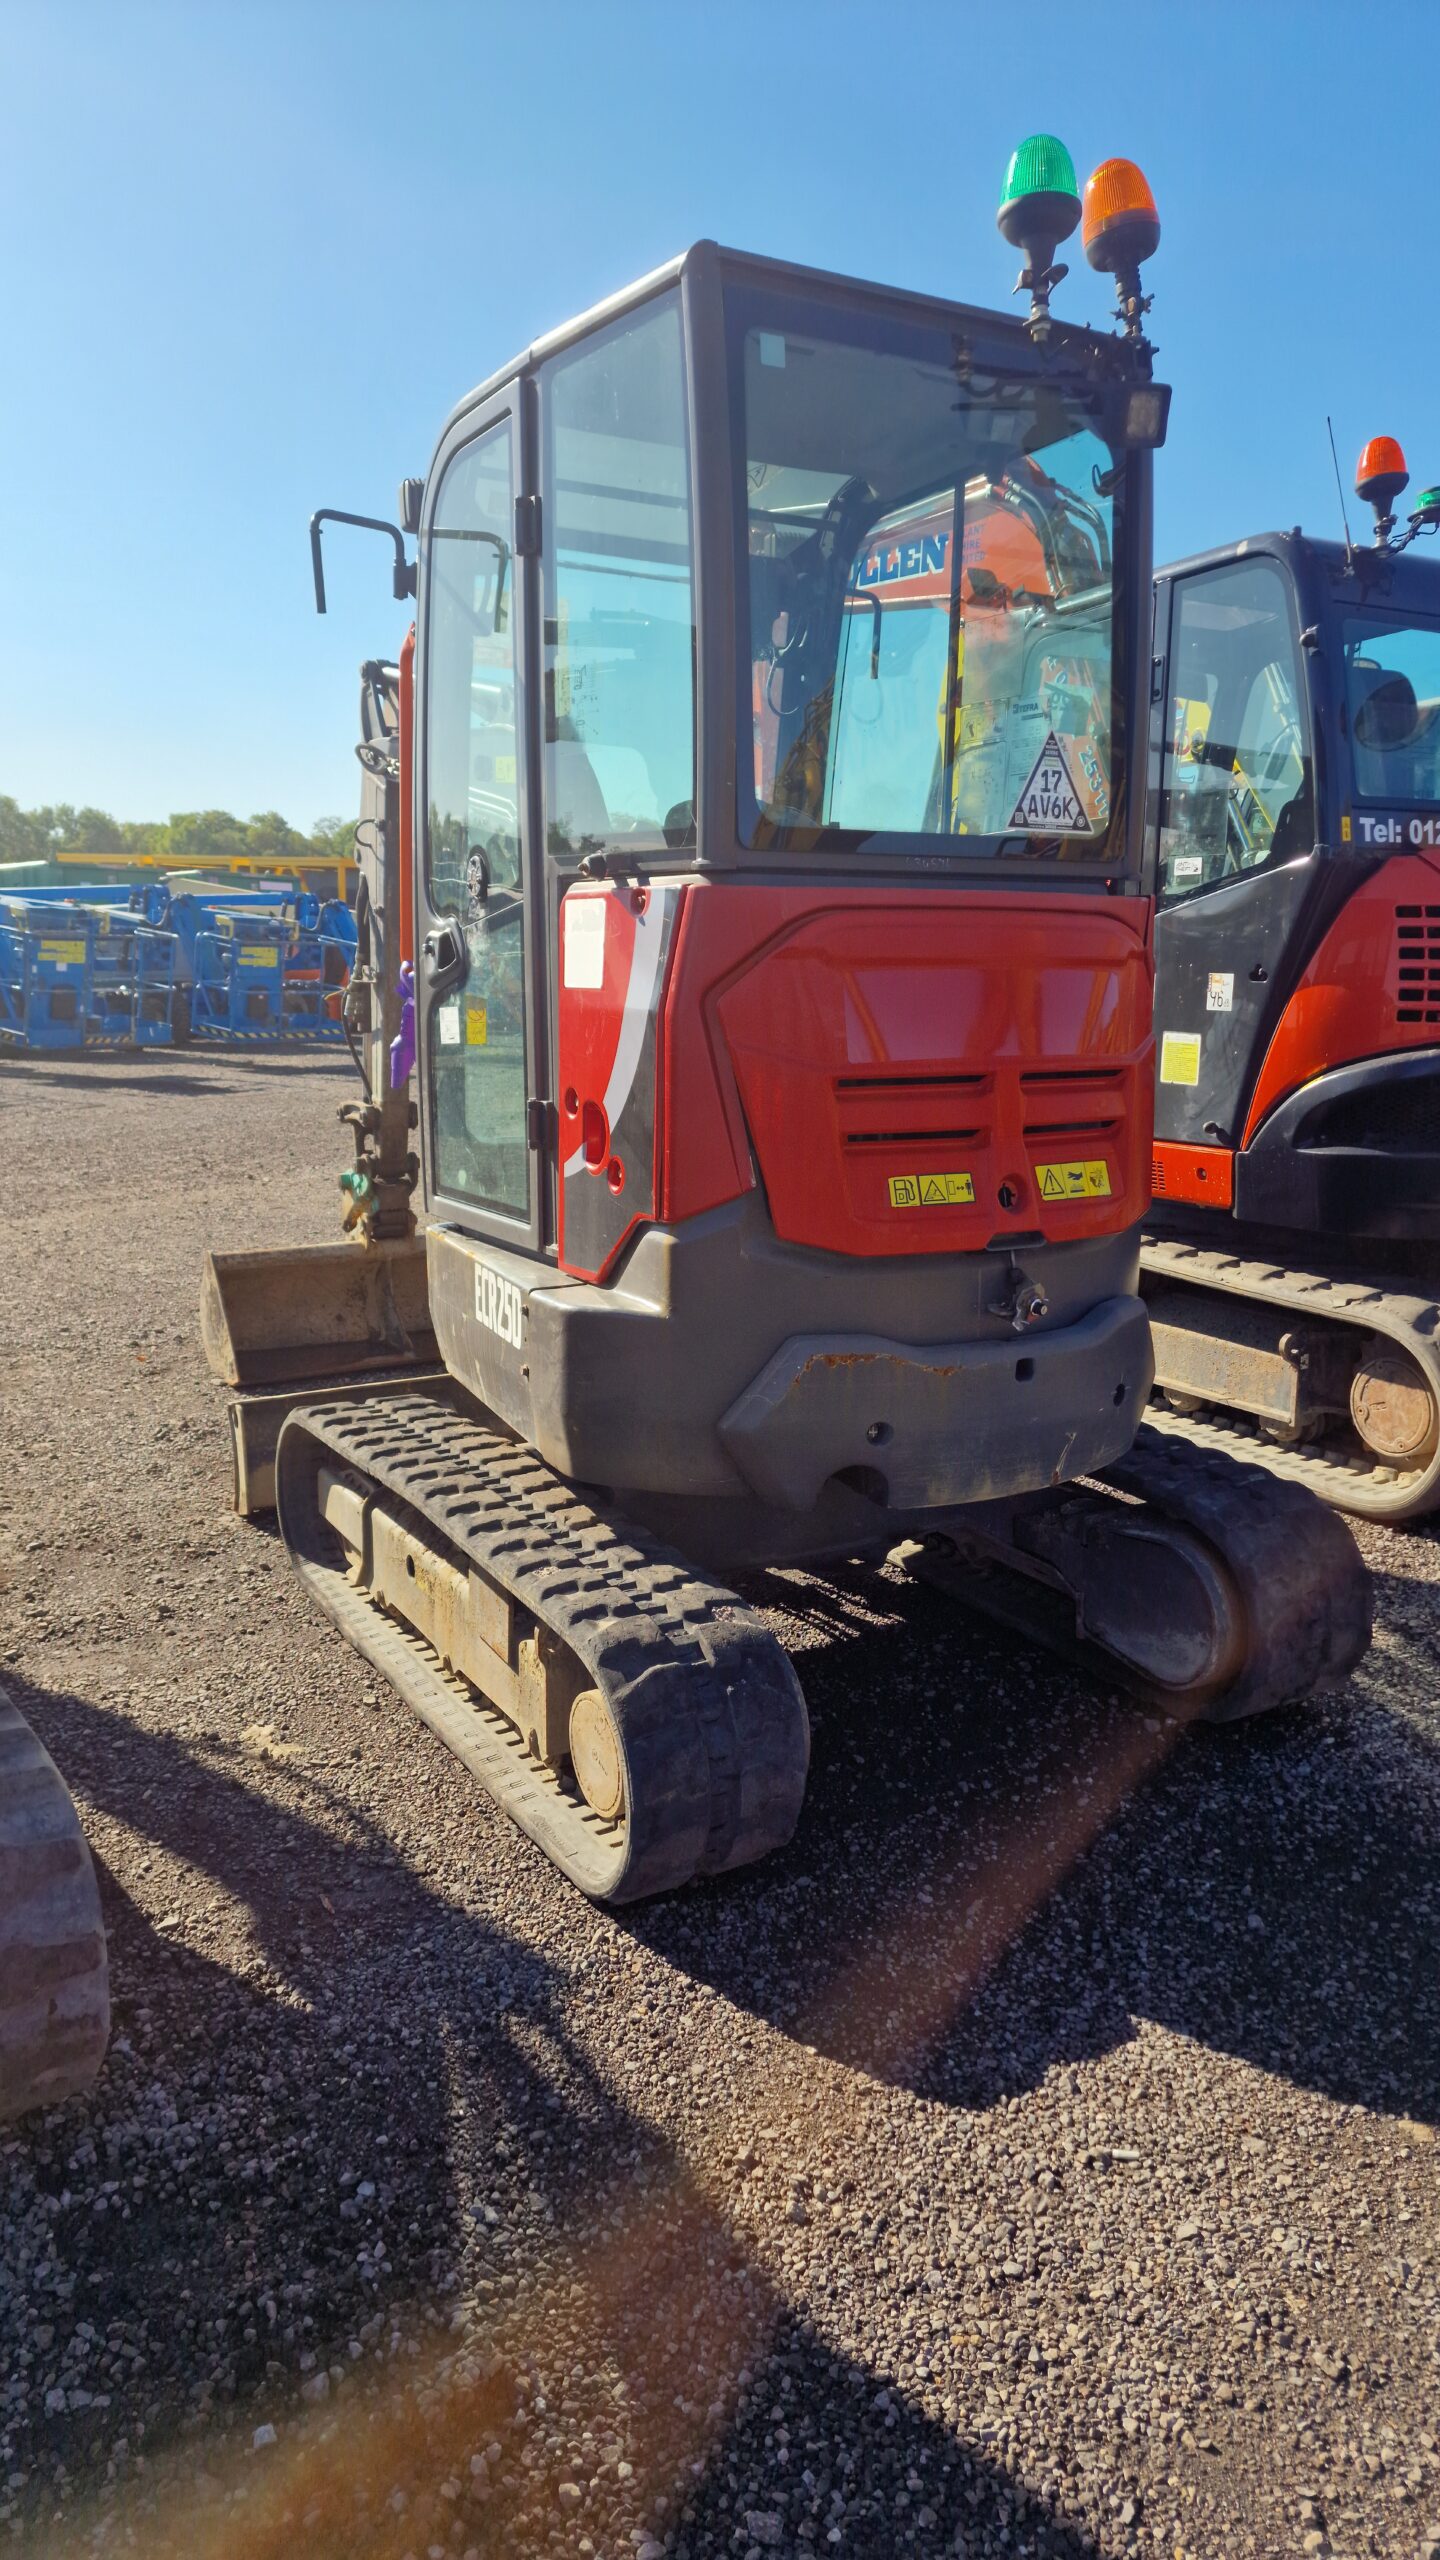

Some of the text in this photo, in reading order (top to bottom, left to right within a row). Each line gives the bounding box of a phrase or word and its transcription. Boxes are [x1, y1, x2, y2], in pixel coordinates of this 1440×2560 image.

[1040, 769, 1063, 793] 17
[1027, 794, 1074, 821] AV6K
[1359, 816, 1402, 843] Tel:
[474, 1261, 522, 1350] ECR25D
